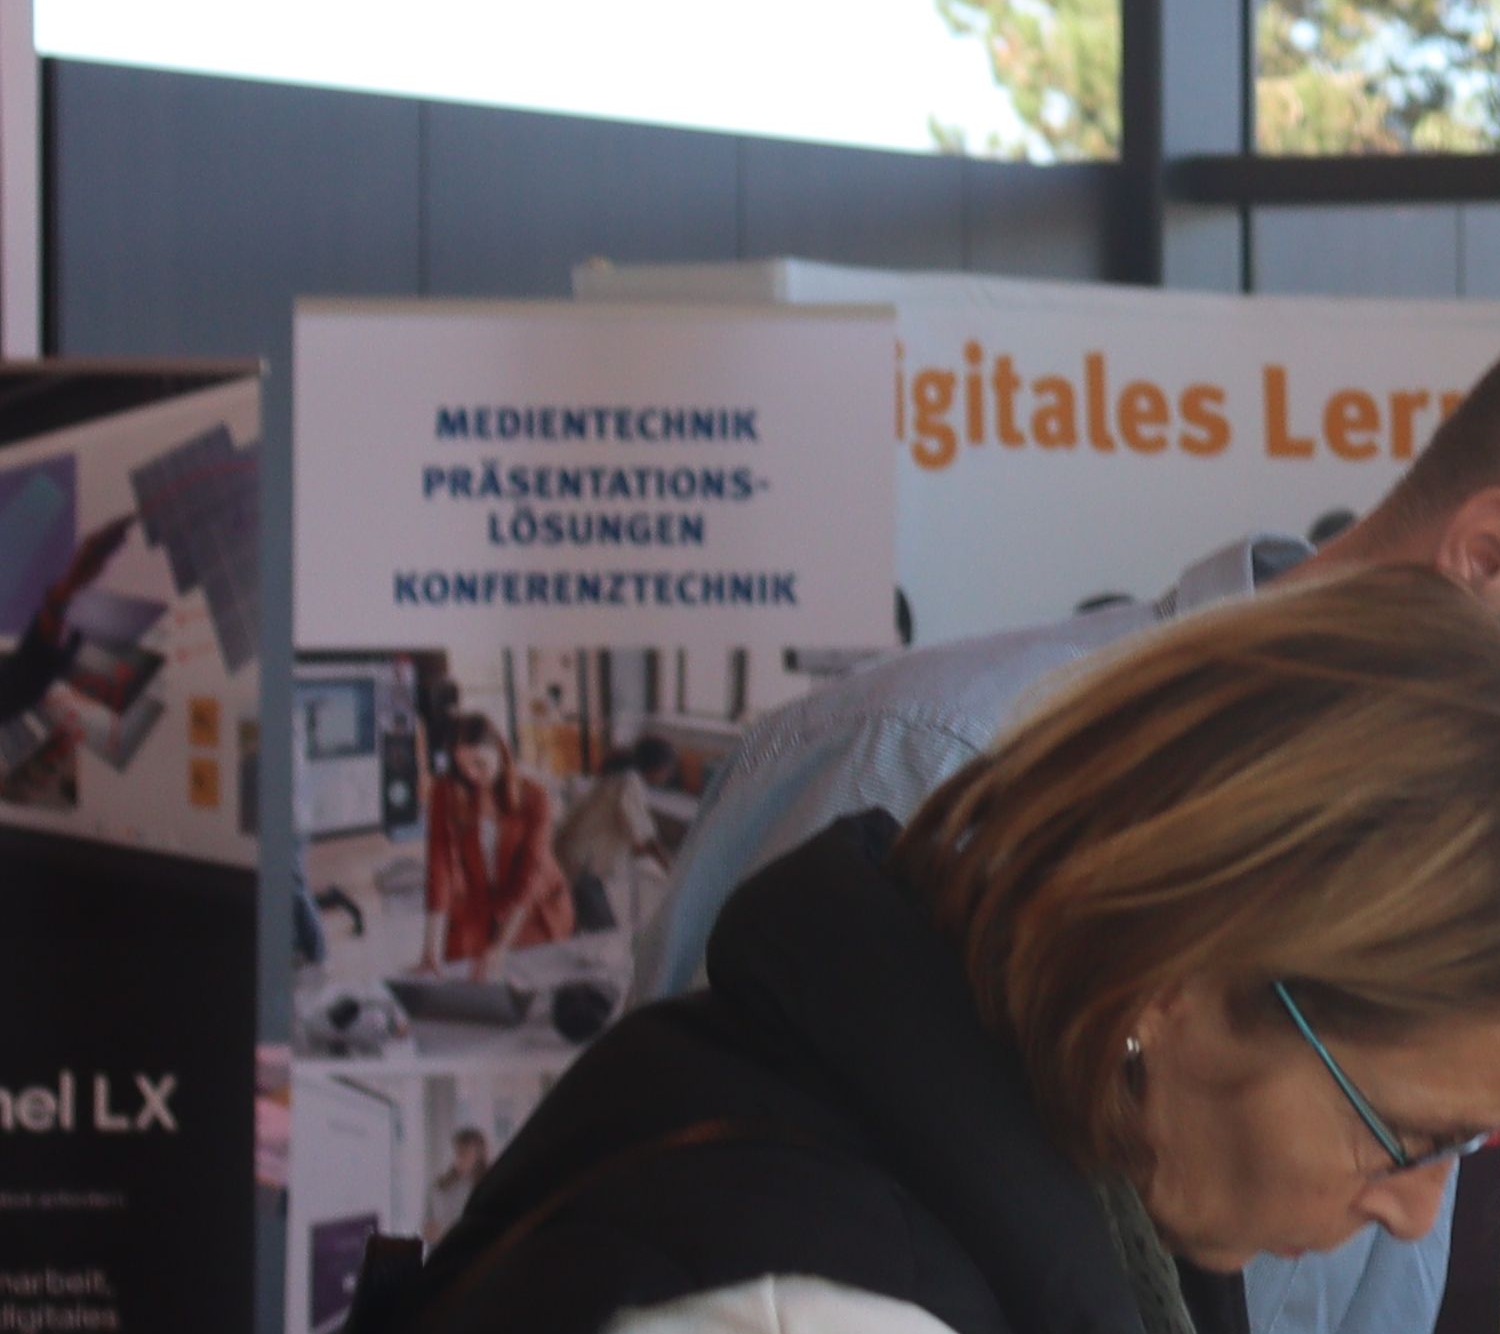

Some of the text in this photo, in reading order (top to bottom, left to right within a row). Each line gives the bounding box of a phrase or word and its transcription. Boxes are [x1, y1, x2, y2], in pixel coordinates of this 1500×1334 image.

[435, 406, 760, 444] MEDIENTECHNIK
[896, 340, 1231, 470] igitales
[1262, 363, 1463, 461] Ler
[422, 464, 771, 501] PRÄSENTATIONS-
[488, 504, 706, 547] LÖSUNGEN
[393, 570, 798, 608] KONFERENZTECHNIK
[92, 1072, 178, 1131] LX
